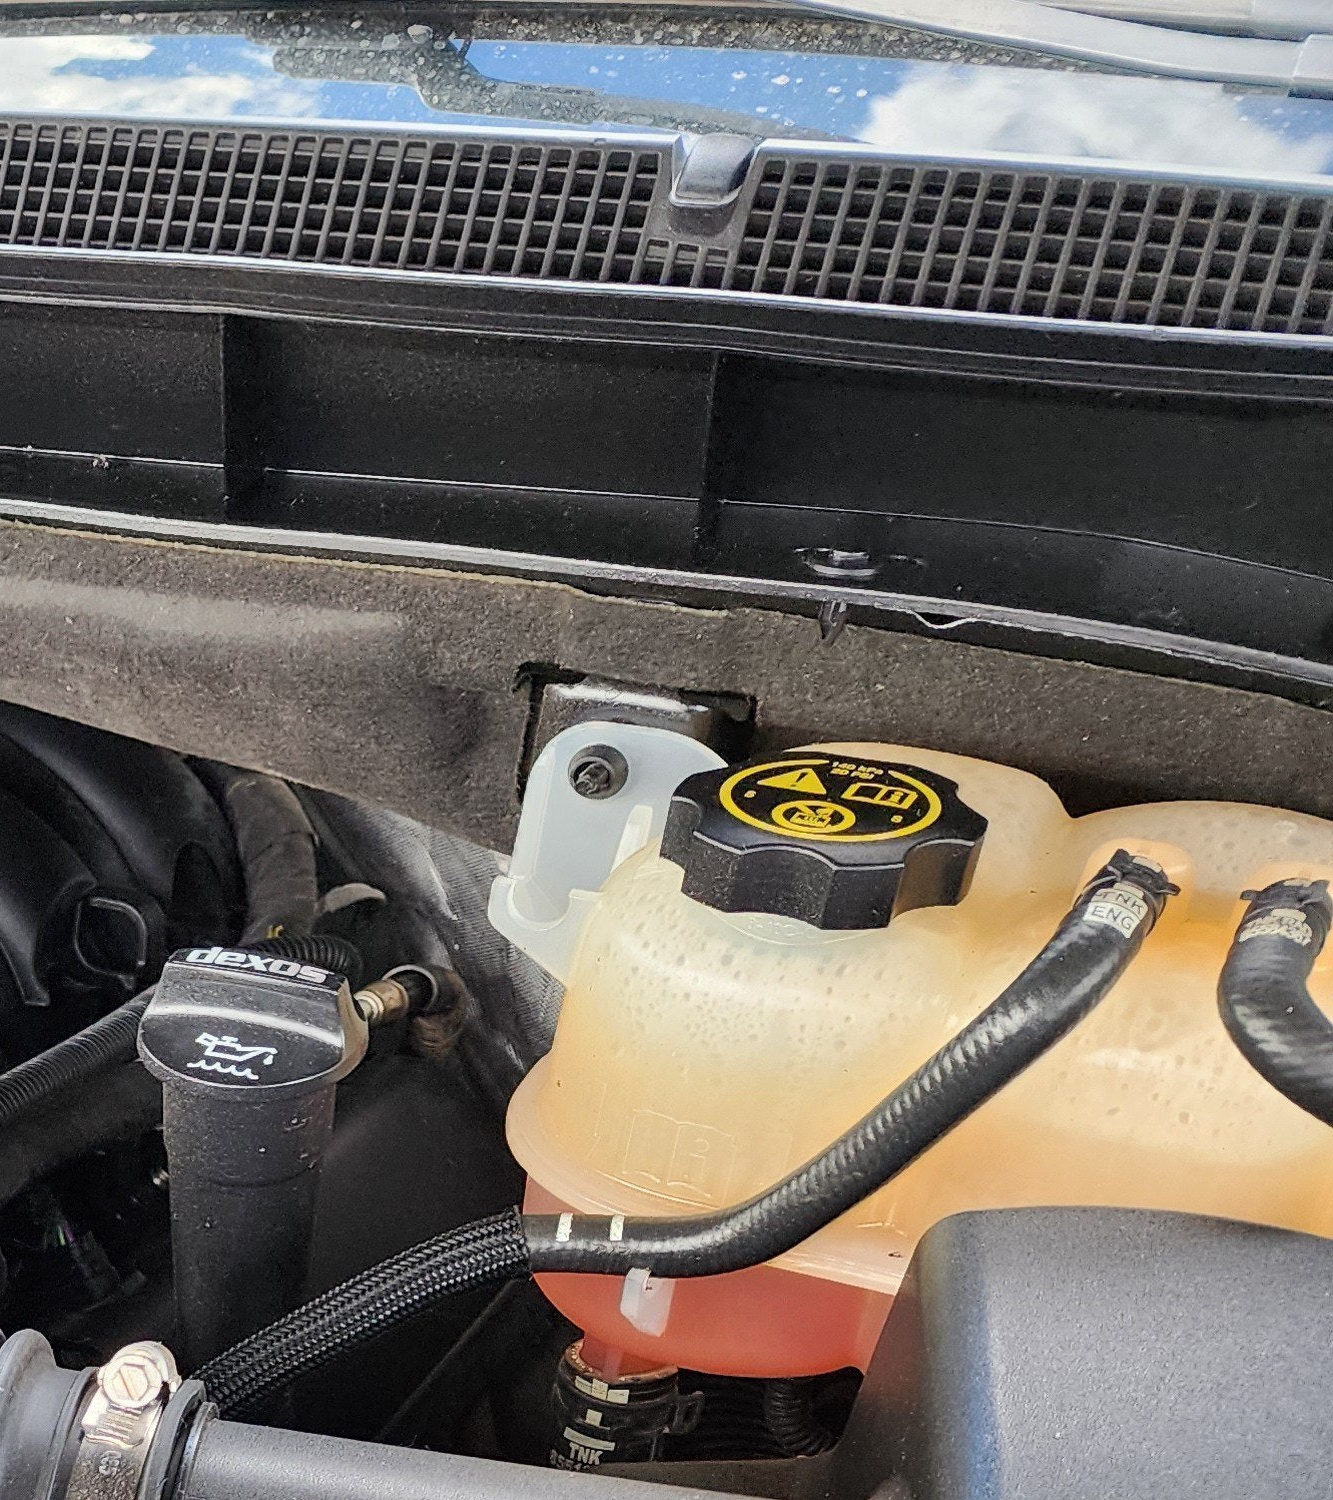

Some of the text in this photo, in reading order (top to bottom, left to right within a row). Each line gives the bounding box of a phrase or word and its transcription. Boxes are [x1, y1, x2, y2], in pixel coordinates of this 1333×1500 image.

[1091, 905, 1134, 930] ENG
[185, 946, 335, 984] dexos
[569, 1441, 603, 1466] TNK
